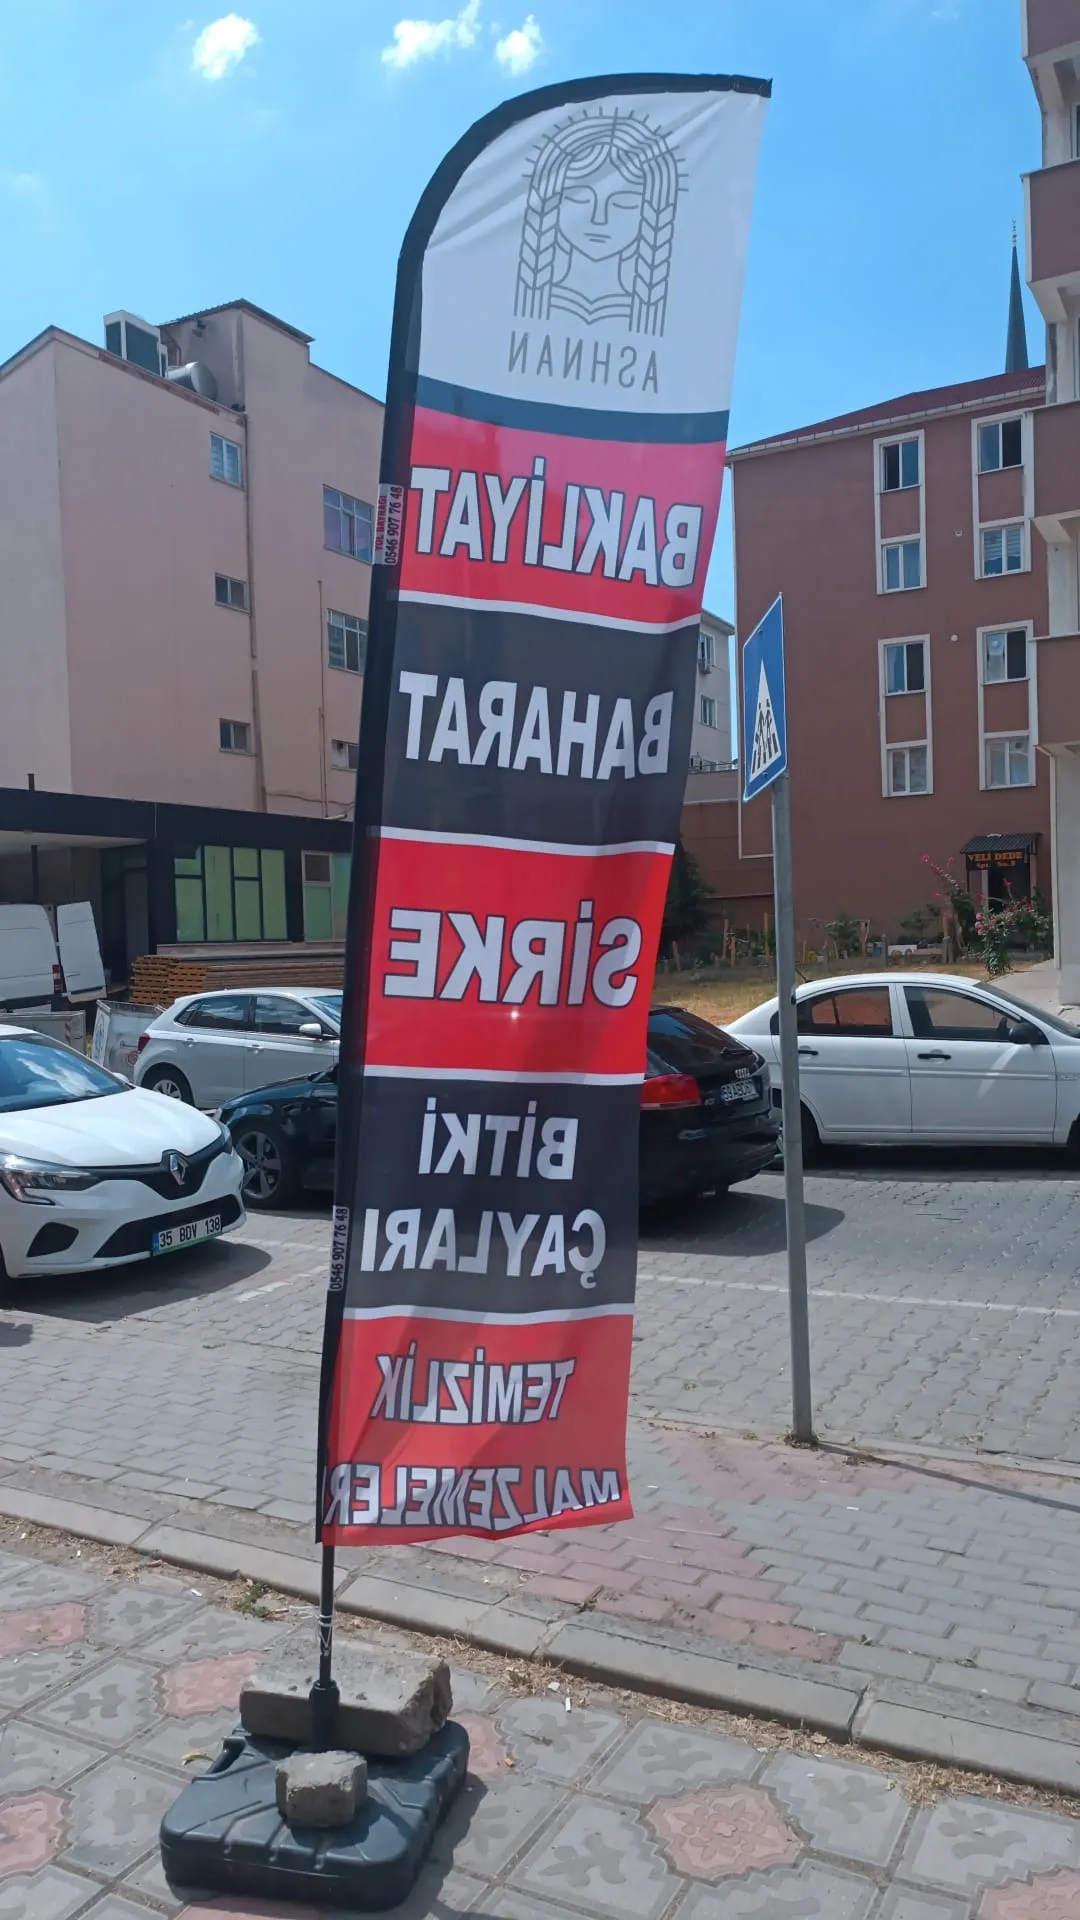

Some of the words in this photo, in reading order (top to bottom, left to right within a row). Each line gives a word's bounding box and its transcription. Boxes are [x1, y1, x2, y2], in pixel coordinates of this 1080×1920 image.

[390, 486, 403, 499] 48
[389, 501, 402, 514] 76
[387, 516, 401, 536] 907
[384, 538, 398, 565] 0546
[335, 1208, 349, 1221] 48
[160, 1231, 172, 1247] 35
[180, 1224, 197, 1242] BDV
[205, 1217, 220, 1234] 138
[333, 1224, 347, 1238] 76
[331, 1241, 345, 1260] 907
[329, 1263, 344, 1290] 0546
